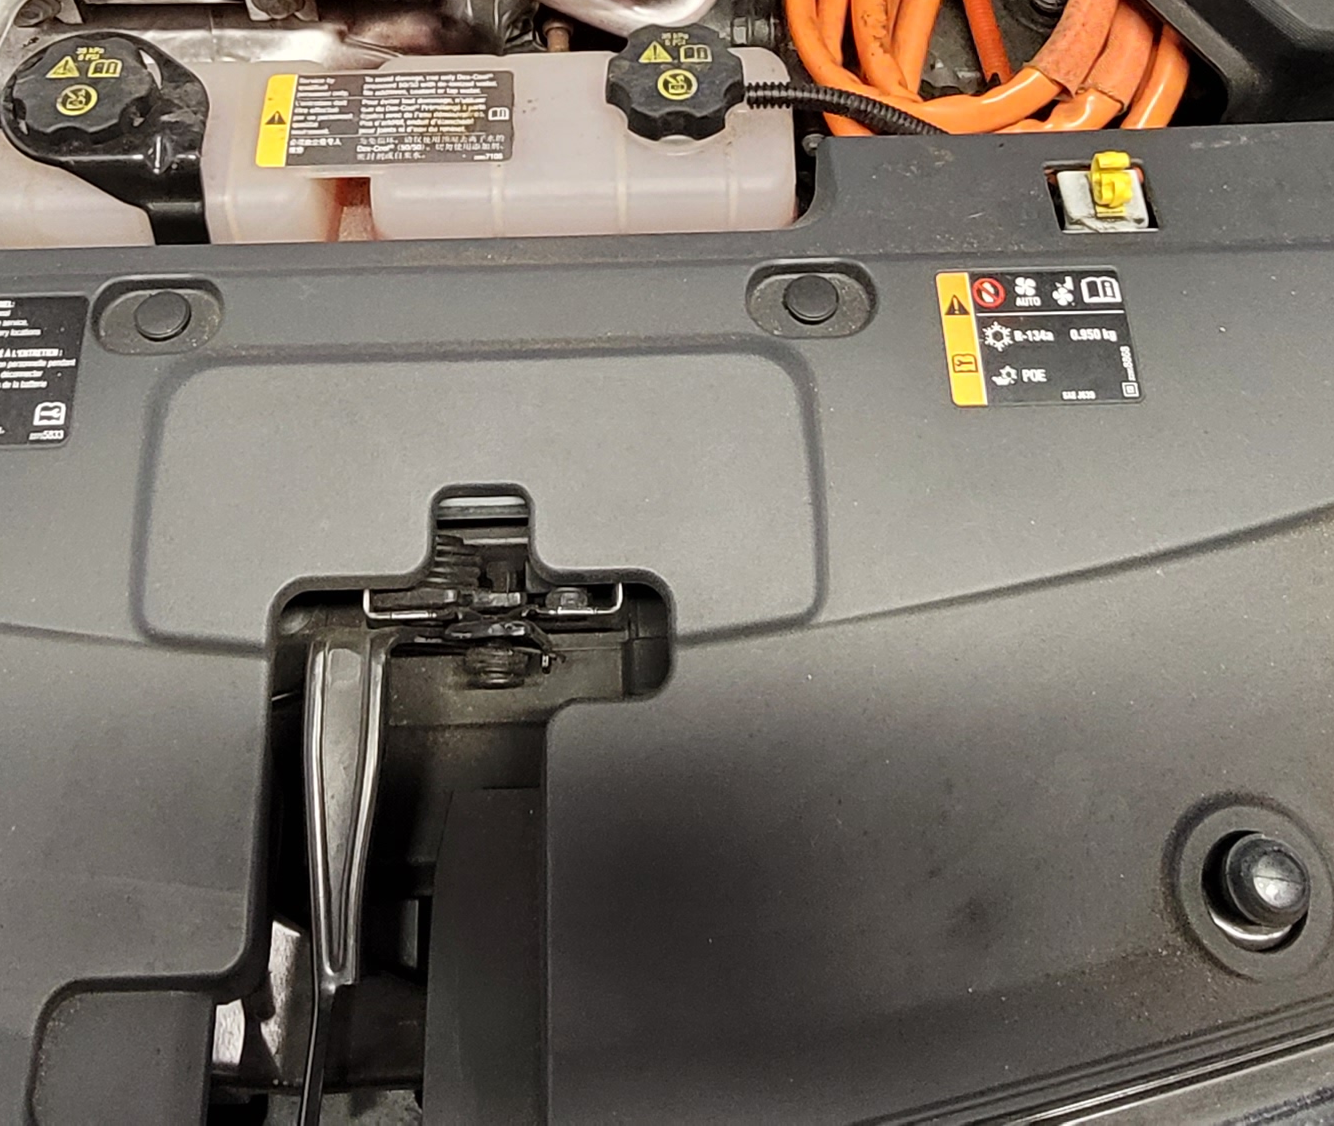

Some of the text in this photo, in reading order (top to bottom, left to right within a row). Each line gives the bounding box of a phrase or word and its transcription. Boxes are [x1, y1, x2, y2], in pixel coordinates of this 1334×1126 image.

[1015, 297, 1042, 307] AUTO
[1013, 328, 1118, 343] R-134a 0.950 kg
[1021, 369, 1047, 383] POE
